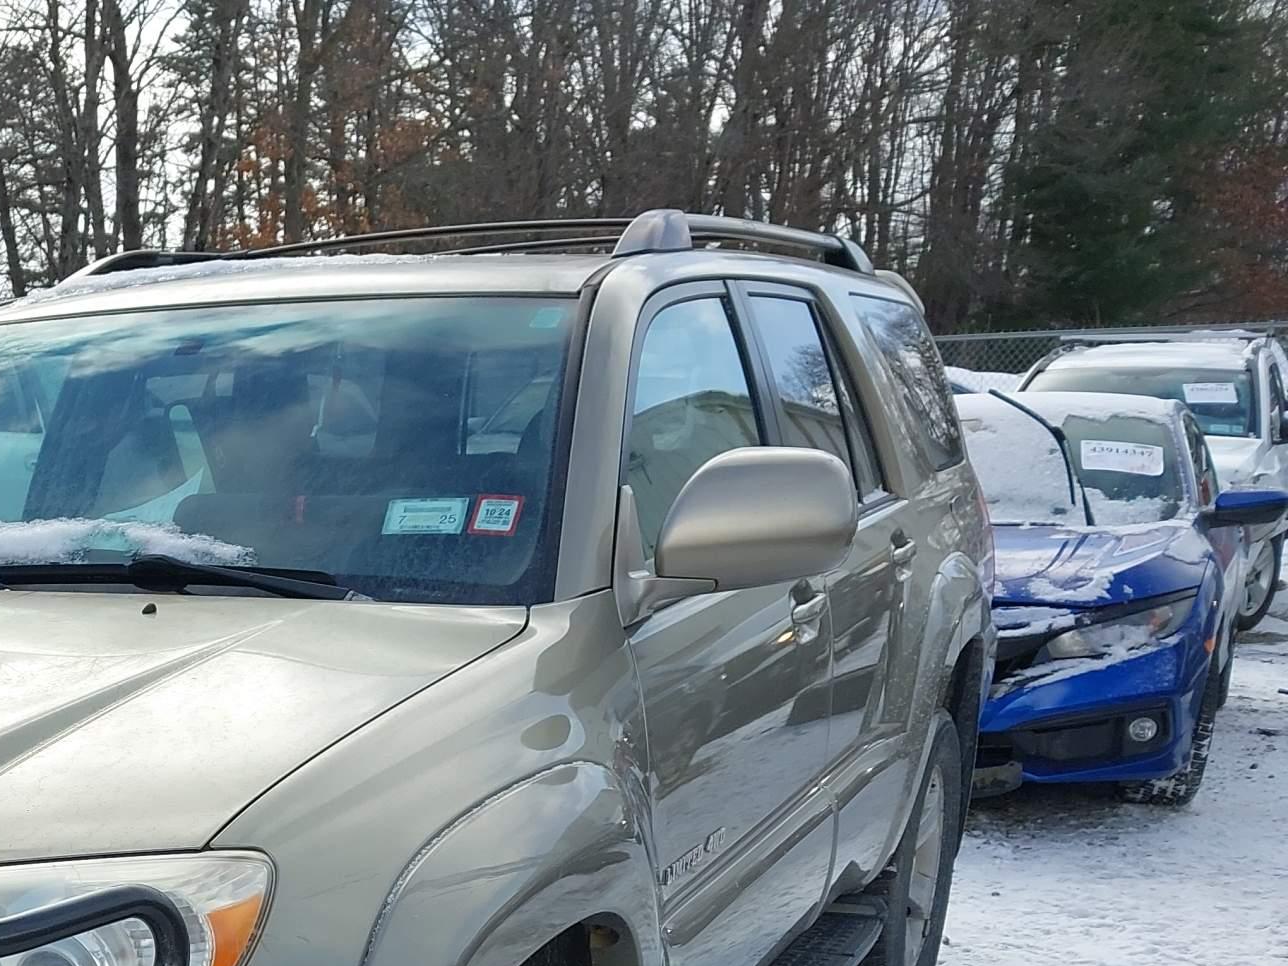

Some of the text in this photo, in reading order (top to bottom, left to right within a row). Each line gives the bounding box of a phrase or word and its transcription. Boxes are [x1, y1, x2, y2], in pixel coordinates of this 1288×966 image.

[498, 508, 511, 516] 24
[398, 514, 457, 525] 7 25
